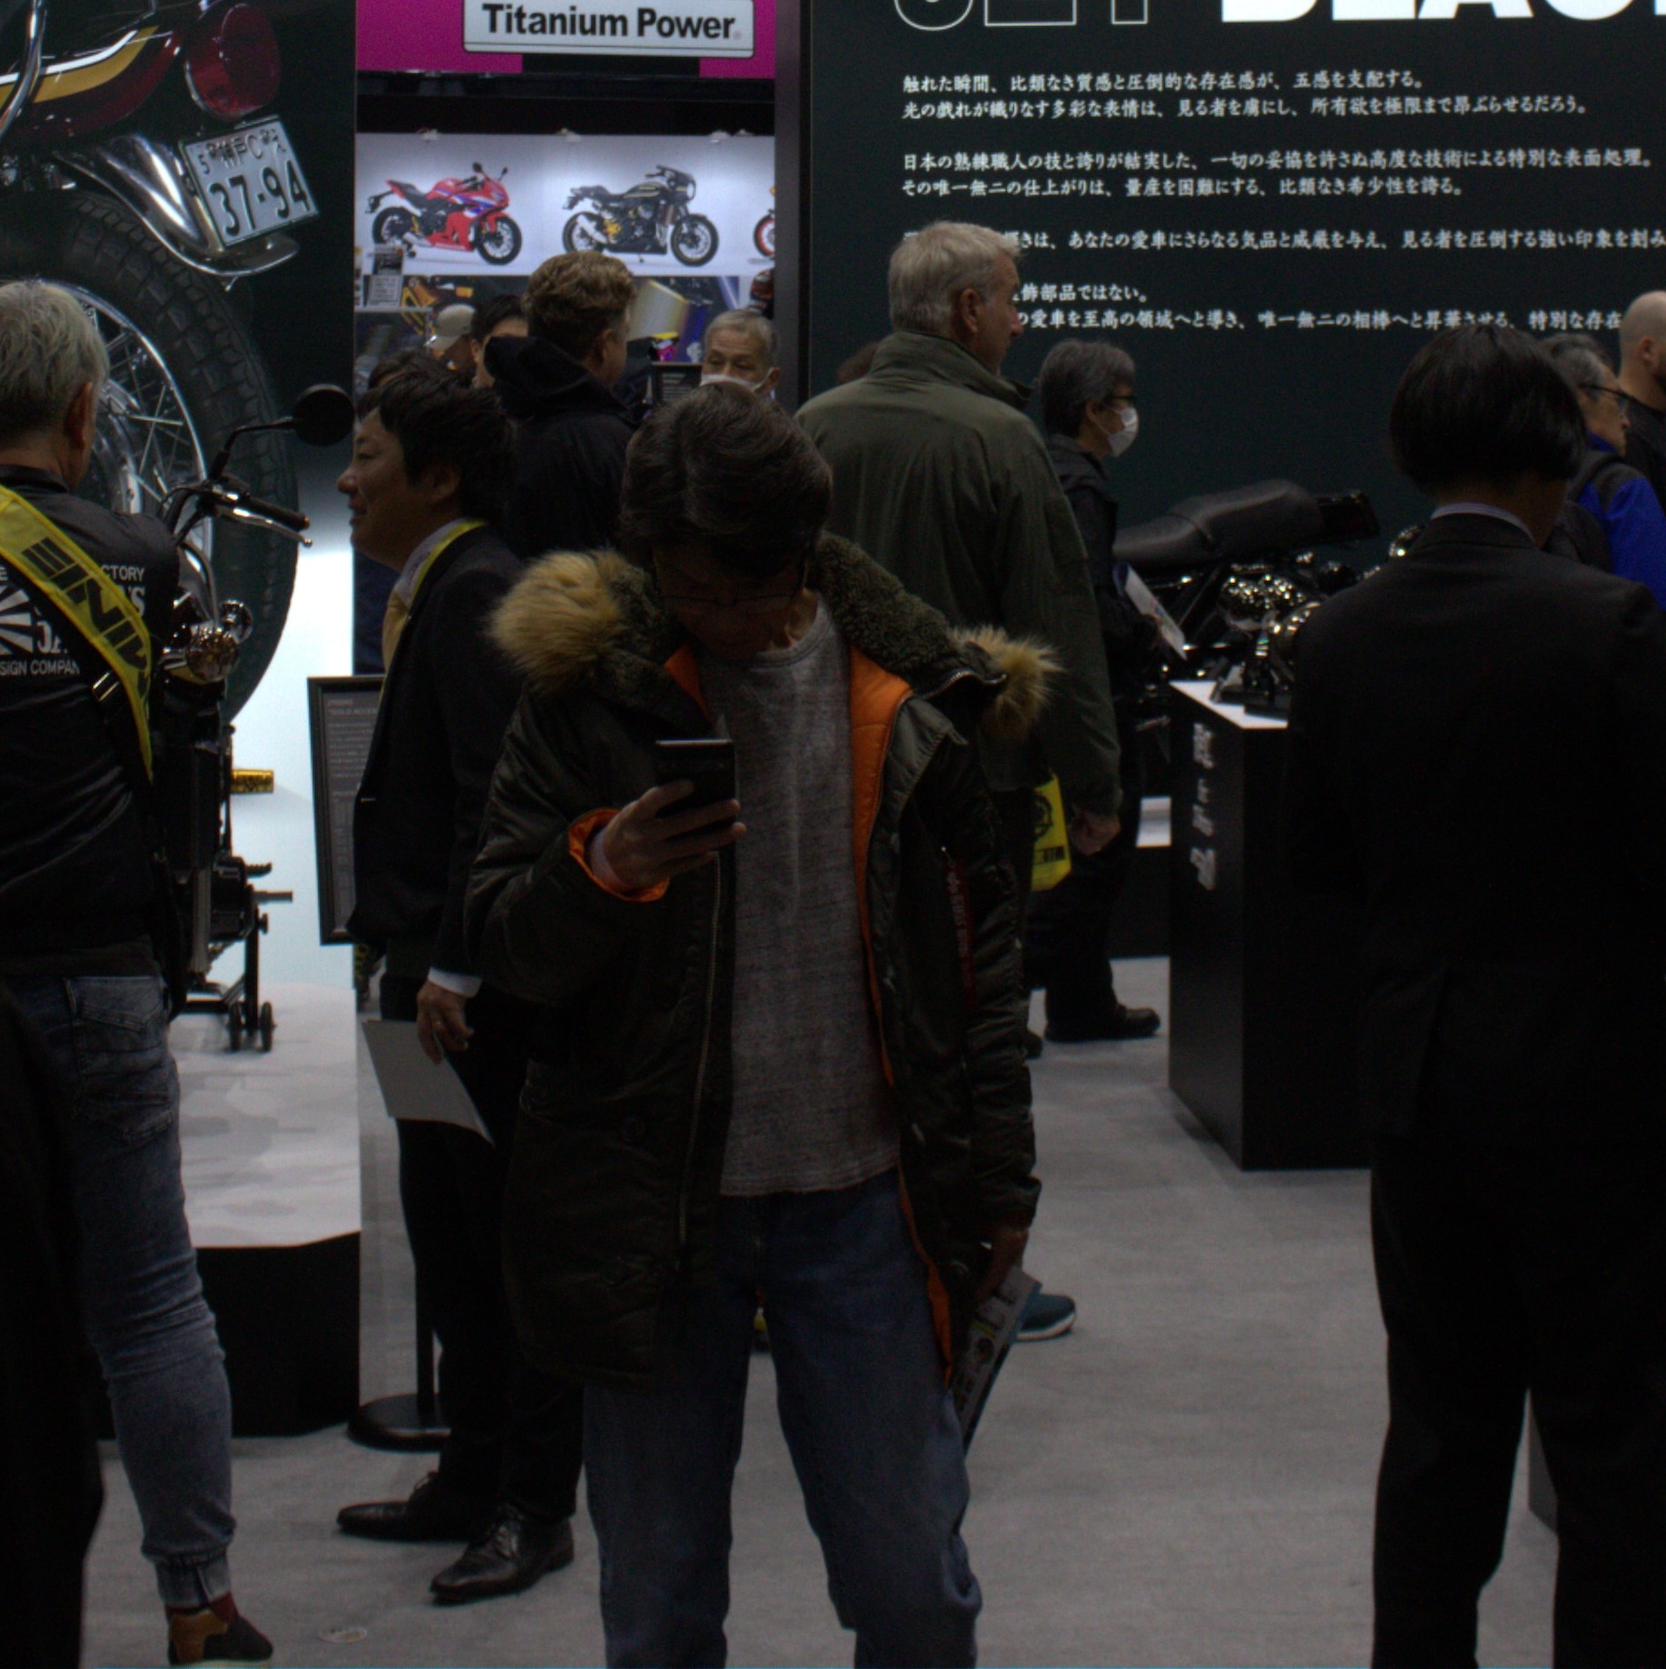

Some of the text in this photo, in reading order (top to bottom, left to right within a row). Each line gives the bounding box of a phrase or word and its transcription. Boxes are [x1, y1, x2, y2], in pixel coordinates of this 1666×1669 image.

[482, 3, 736, 40] Titanium Power
[208, 161, 311, 237] 37-94
[1013, 282, 1148, 303] 飾部品ではない。
[30, 658, 81, 676] COMPAN
